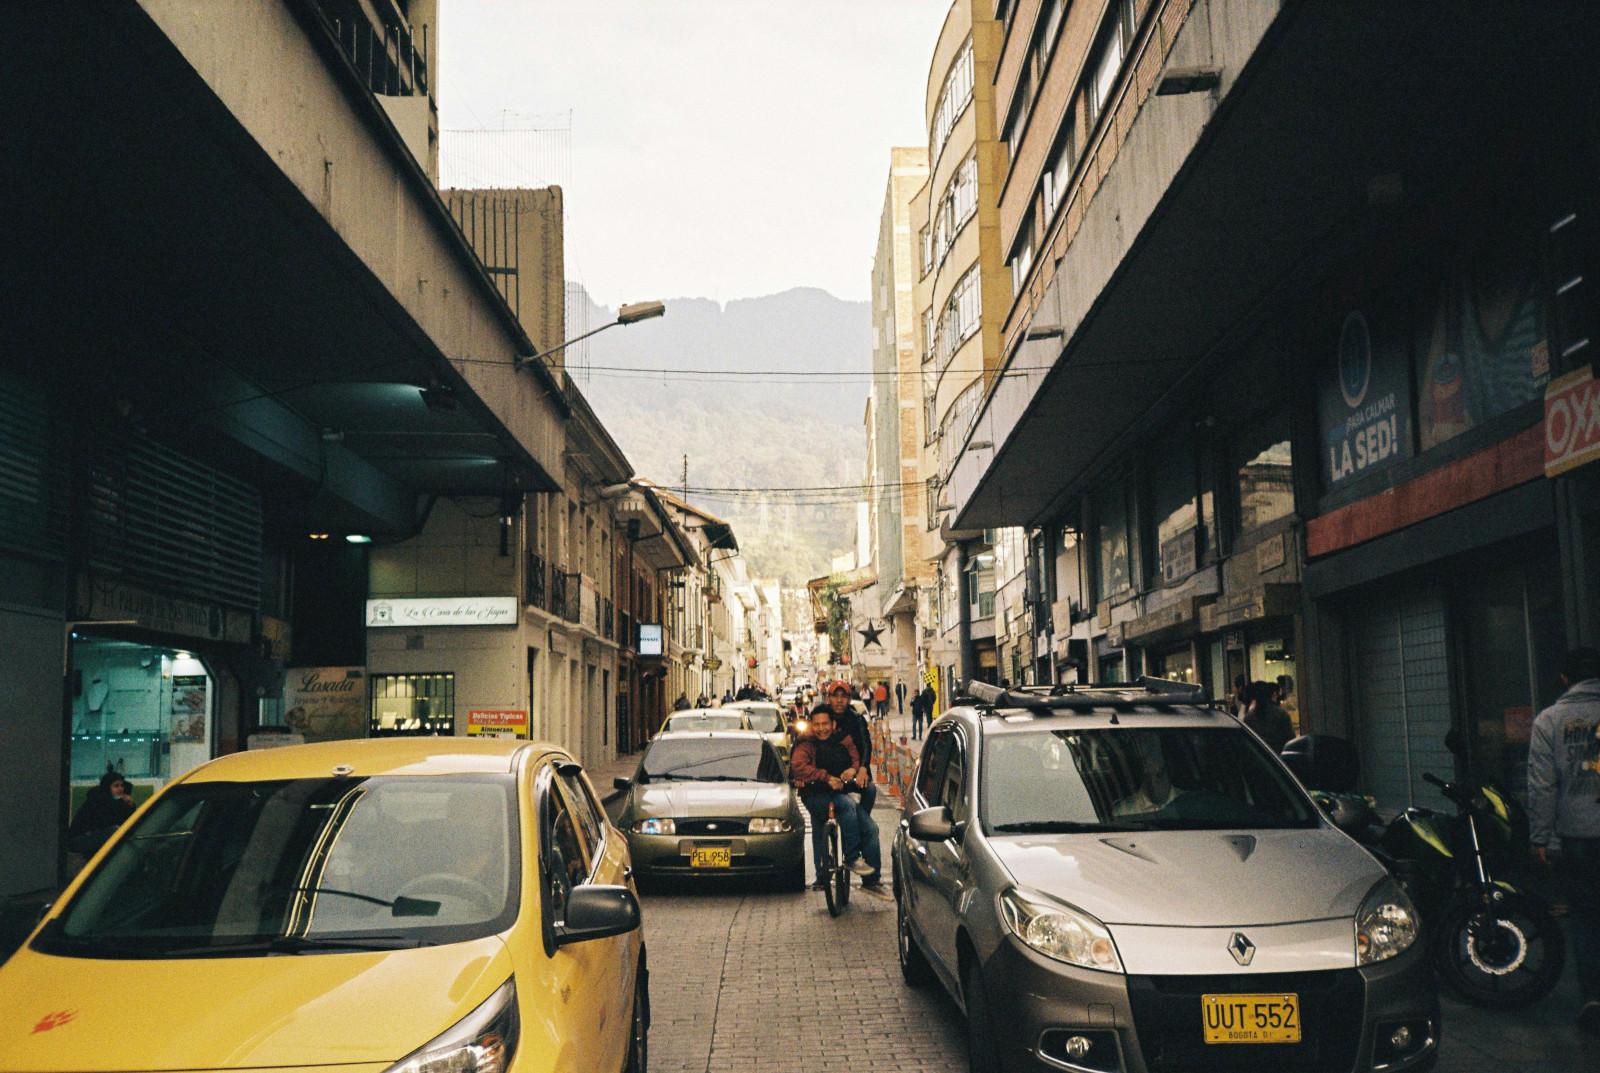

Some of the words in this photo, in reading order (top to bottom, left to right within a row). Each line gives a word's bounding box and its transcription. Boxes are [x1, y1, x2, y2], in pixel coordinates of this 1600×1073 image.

[1330, 439, 1354, 482] LA
[1355, 414, 1398, 469] SED!
[452, 606, 463, 616] de
[464, 606, 476, 616] las
[297, 673, 356, 692] Losada
[692, 851, 707, 862] PEL
[711, 851, 729, 862] 958
[1206, 1004, 1248, 1029] UUT
[1254, 1003, 1296, 1028] 552
